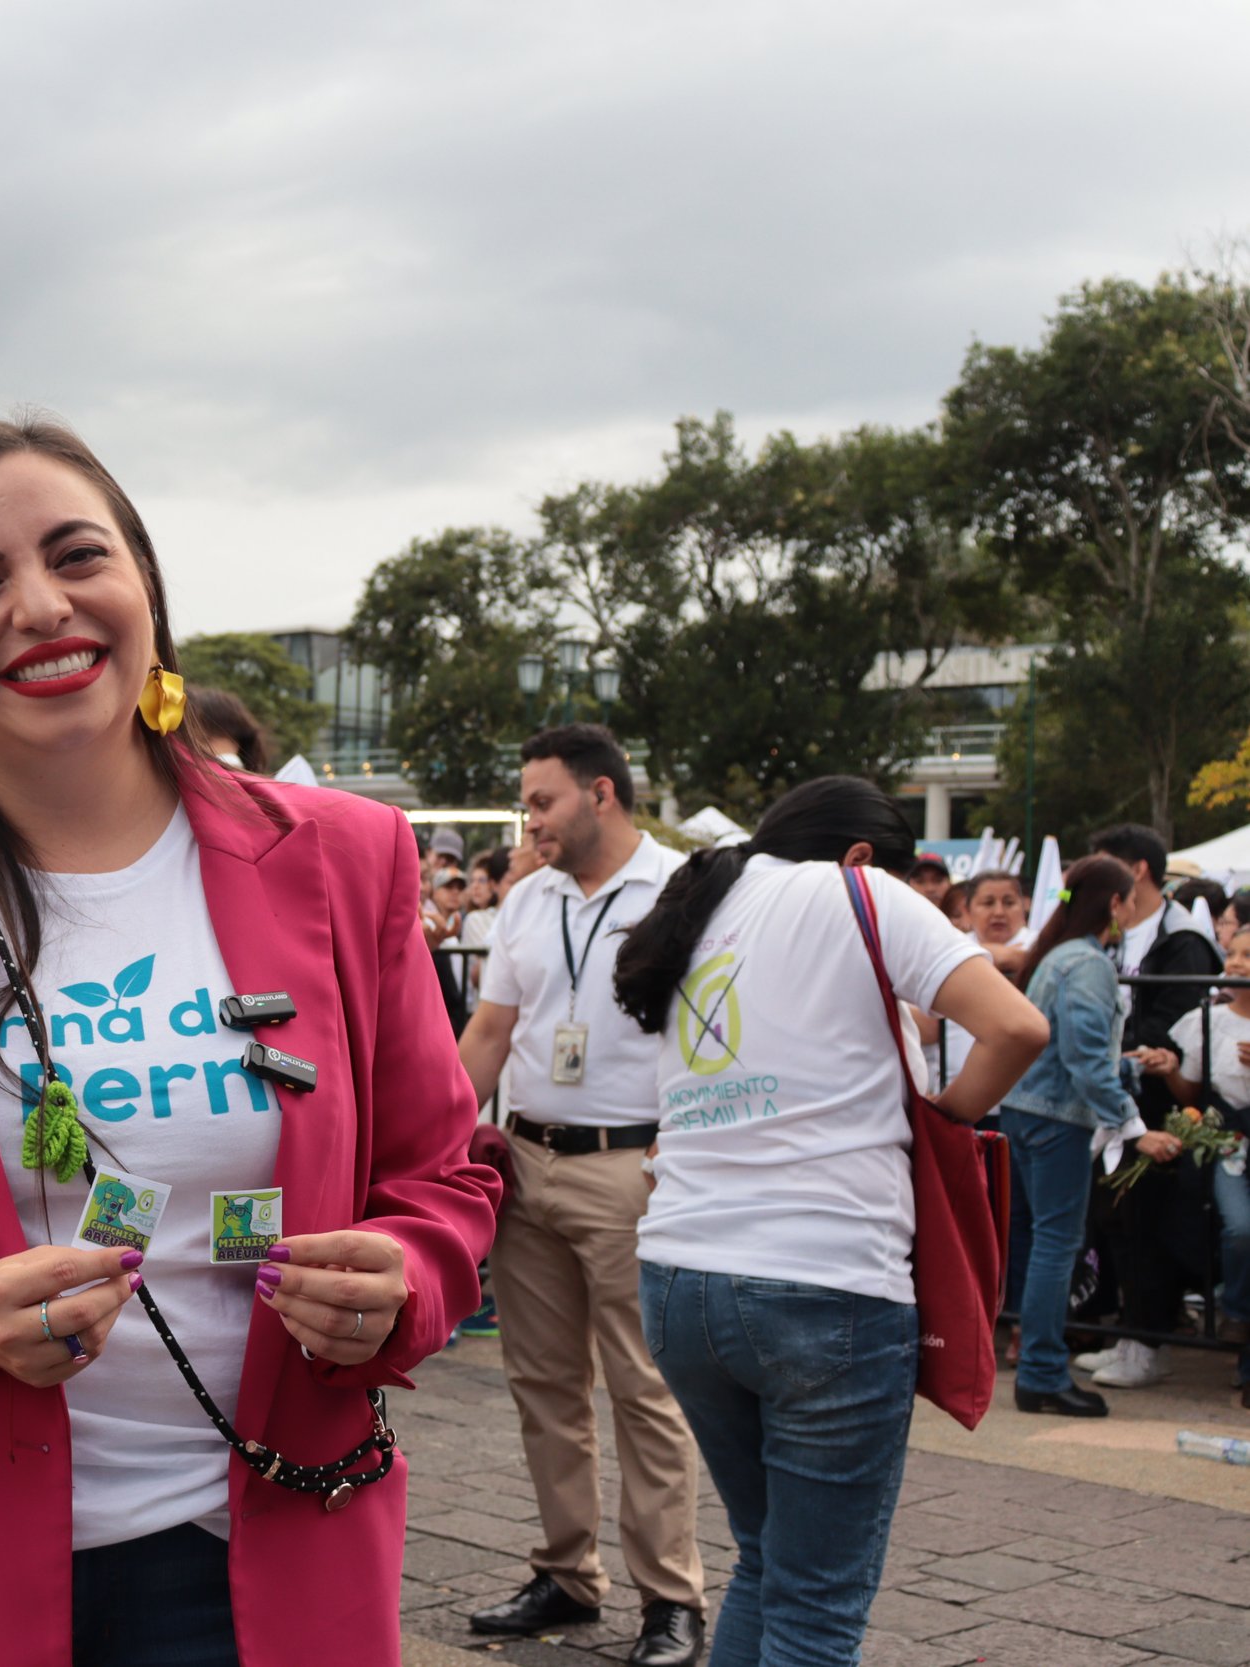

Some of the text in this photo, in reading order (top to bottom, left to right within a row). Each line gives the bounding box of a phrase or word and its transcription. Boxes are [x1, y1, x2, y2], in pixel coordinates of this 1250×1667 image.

[254, 994, 288, 1003] HOLLYLAND
[281, 1055, 315, 1072] HOLLYLAND
[668, 1075, 779, 1107] MOVIMIENTO
[91, 1220, 135, 1240] CHUCHIS
[219, 1236, 266, 1248] MICHIS
